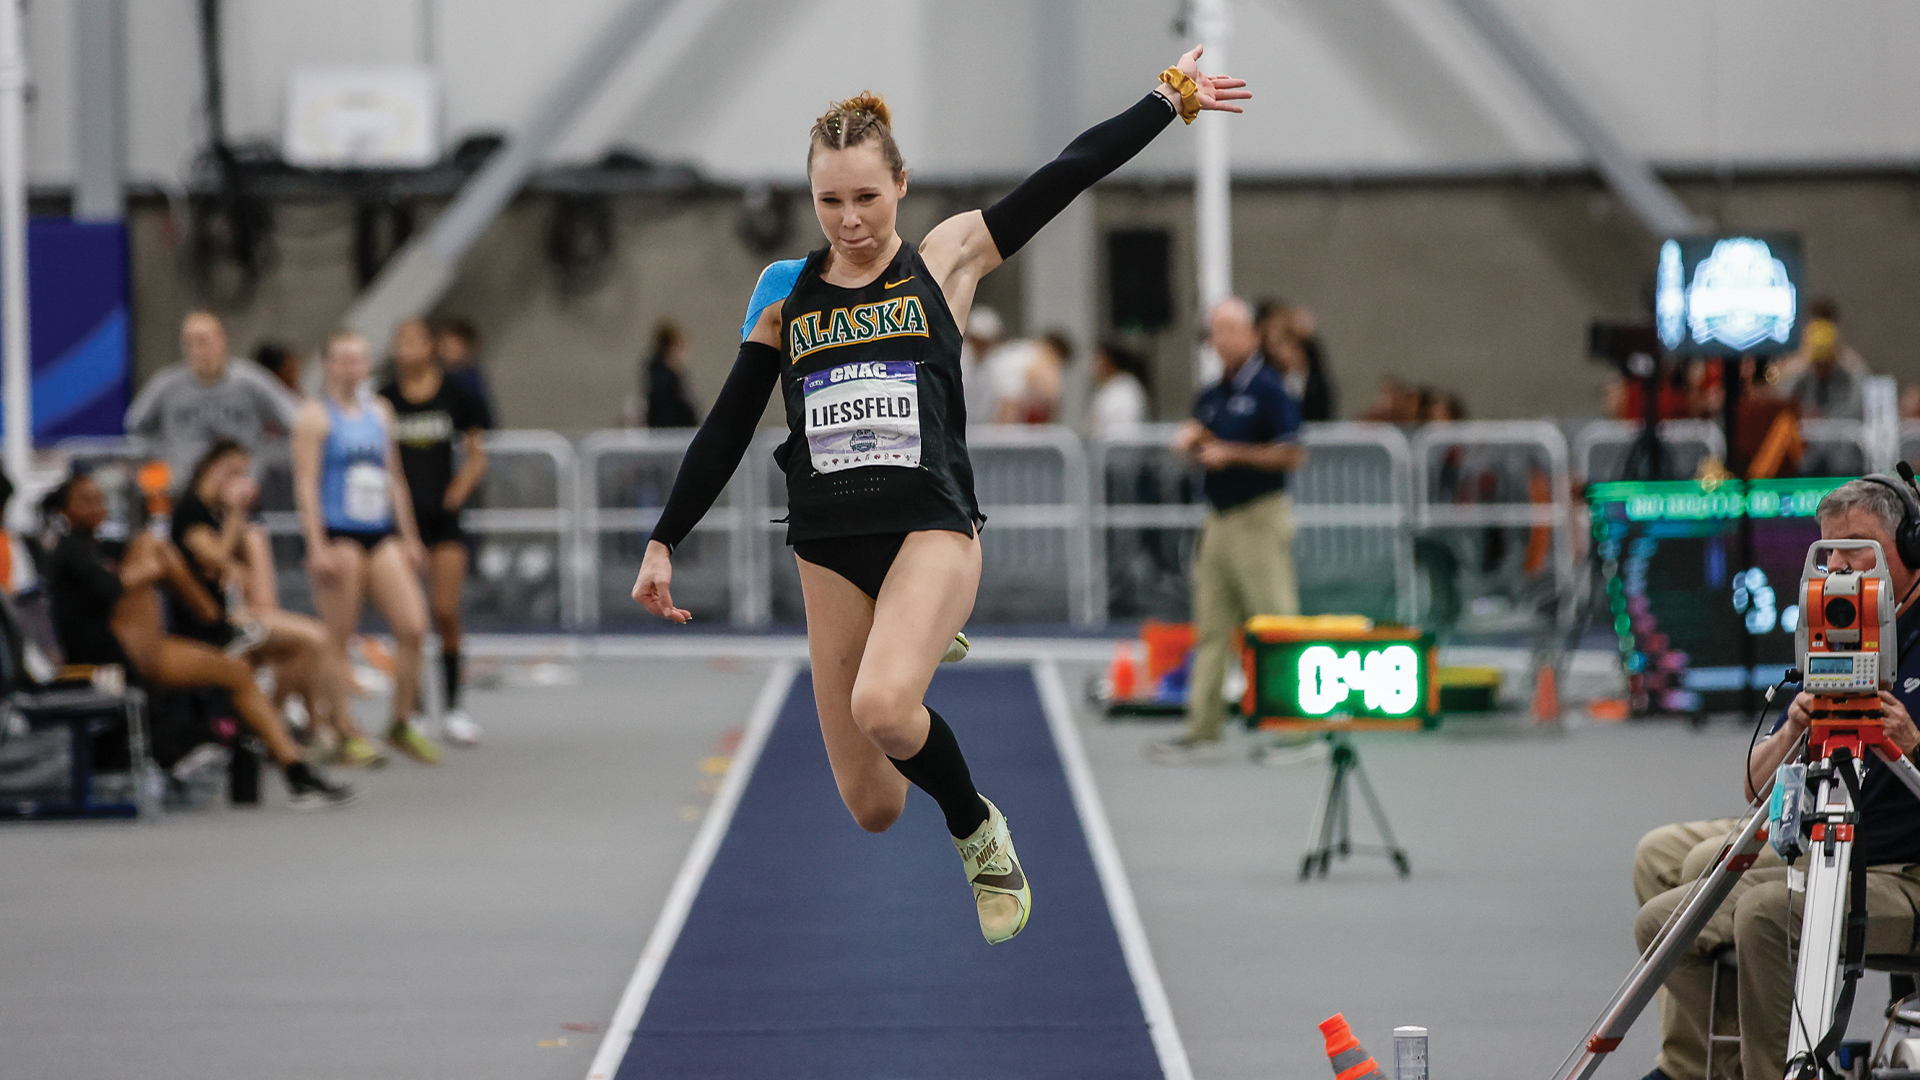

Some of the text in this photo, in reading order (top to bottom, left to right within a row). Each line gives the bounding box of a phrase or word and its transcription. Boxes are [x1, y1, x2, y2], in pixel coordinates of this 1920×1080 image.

[790, 296, 929, 364] ALASKA
[830, 363, 887, 383] GNAC
[812, 397, 911, 427] LIESSFELD
[1298, 645, 1418, 714] 0:48
[976, 836, 999, 869] NIKE
